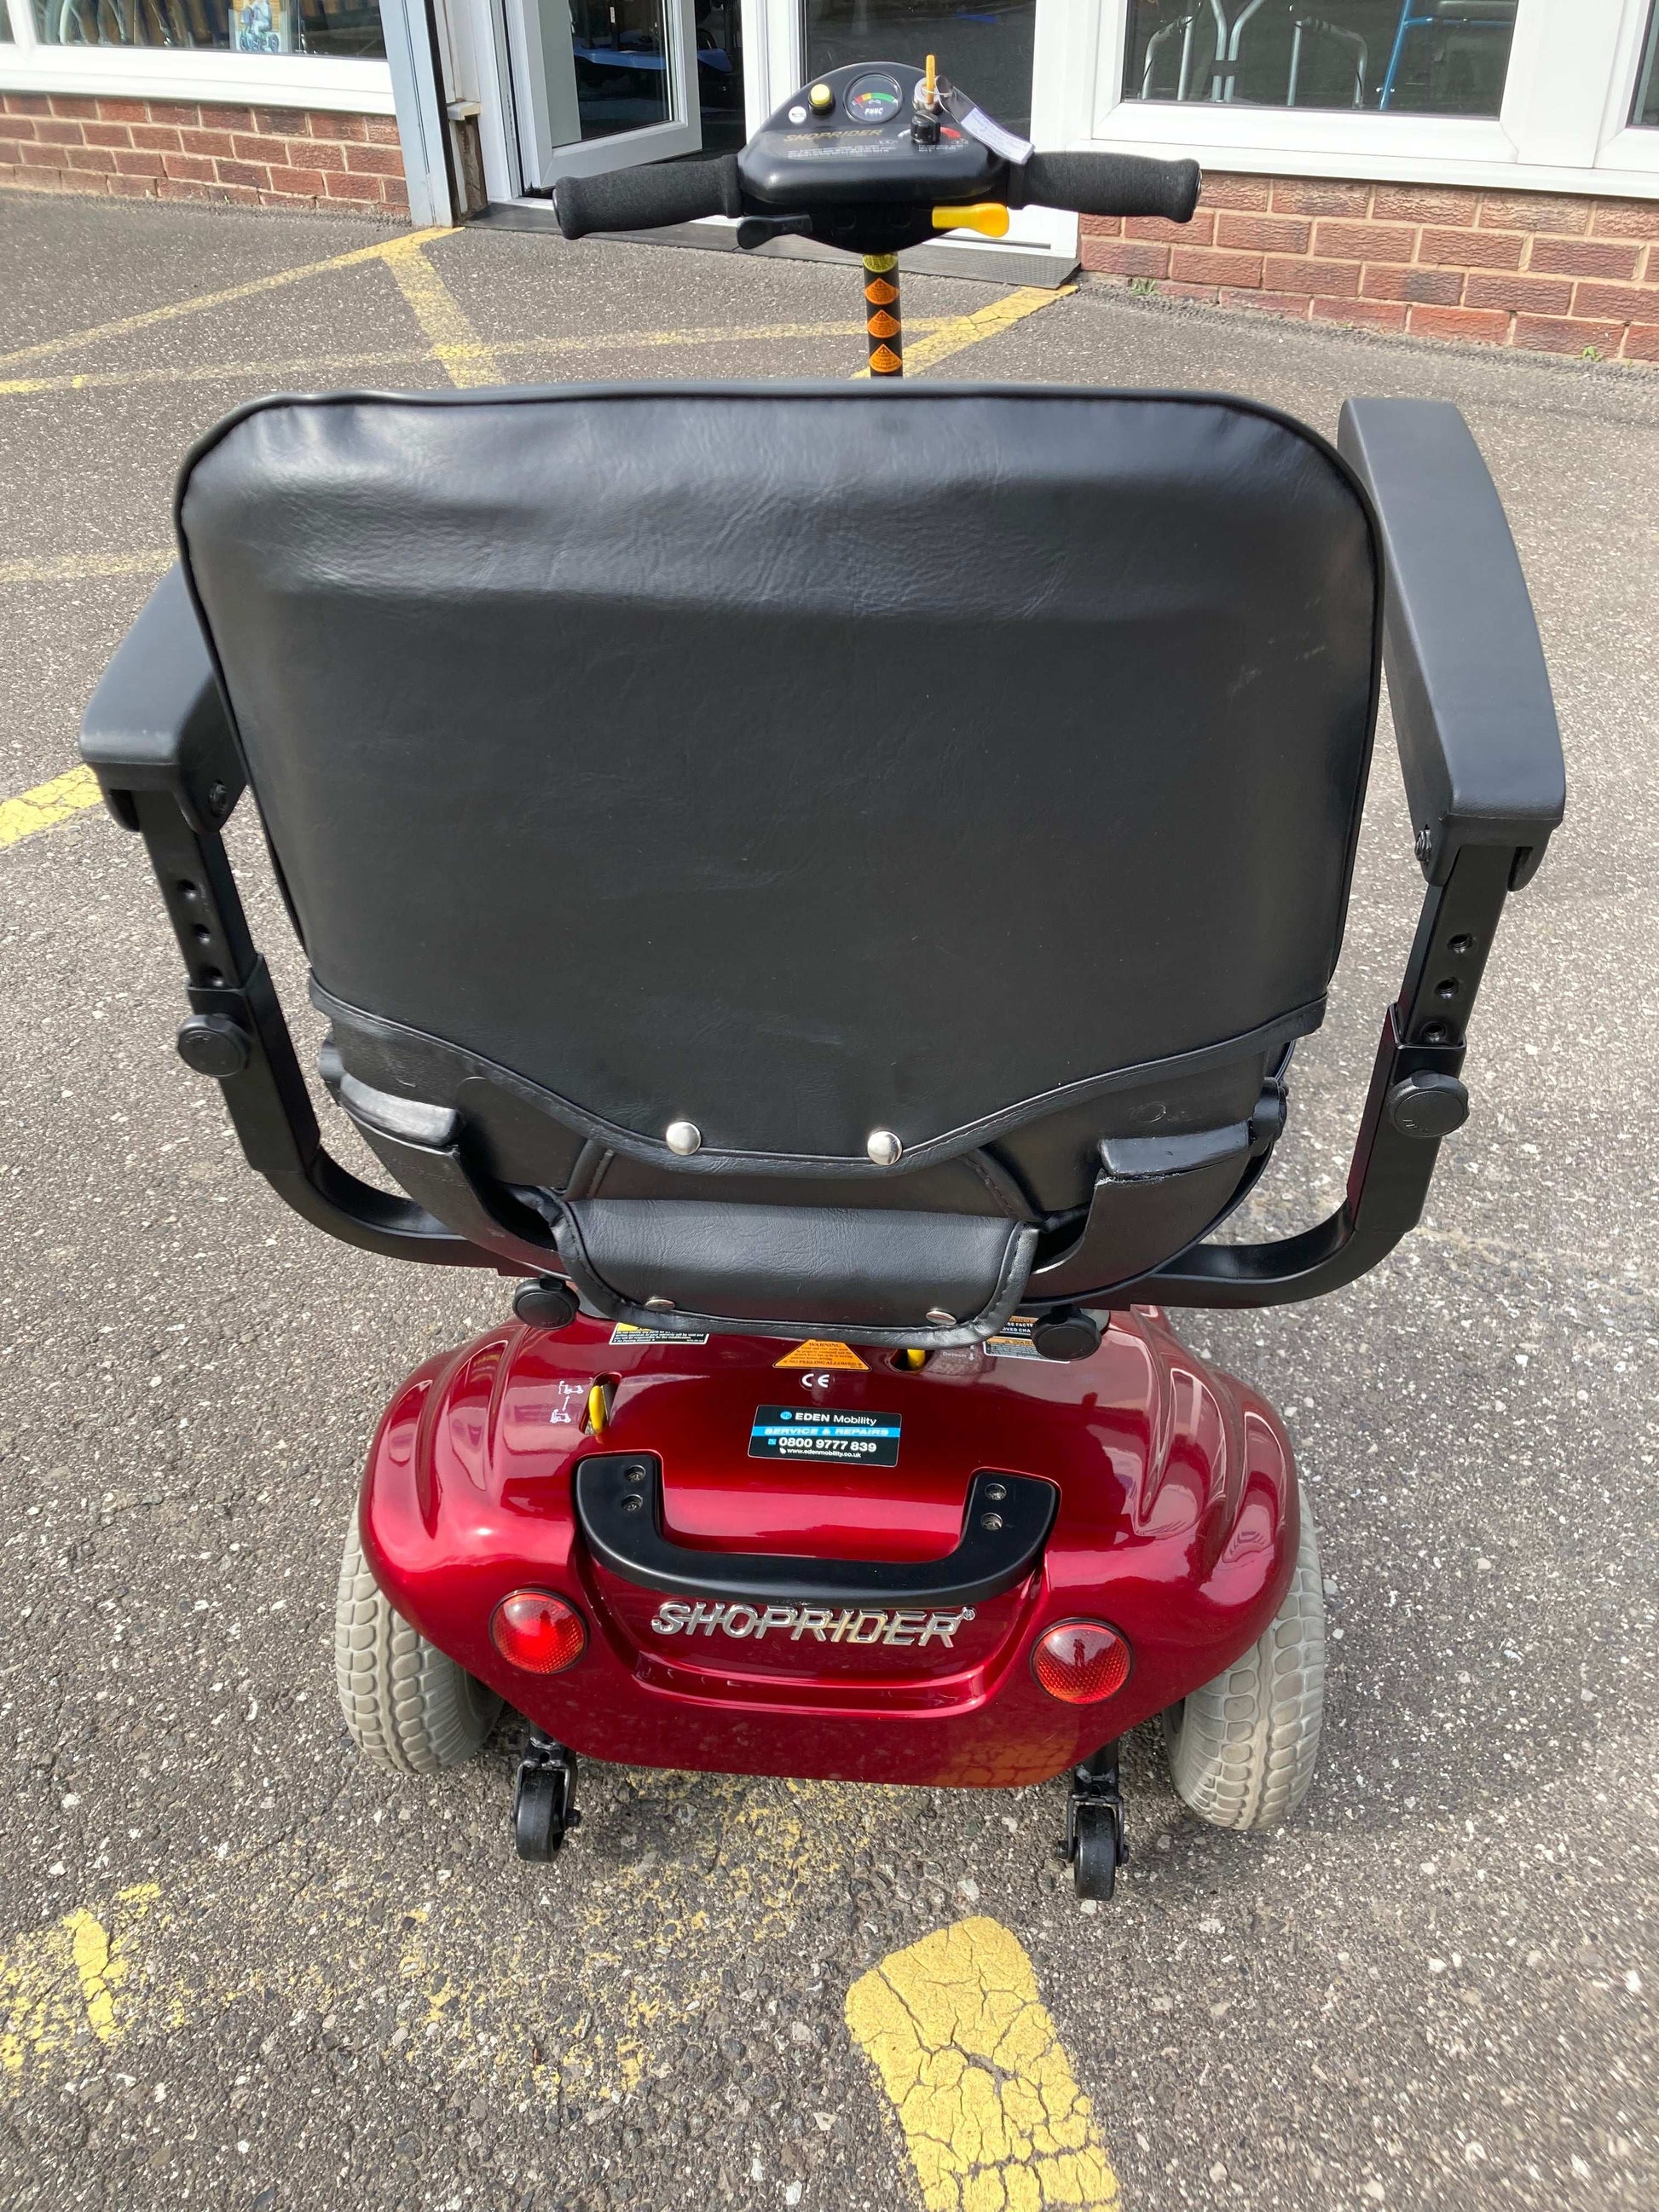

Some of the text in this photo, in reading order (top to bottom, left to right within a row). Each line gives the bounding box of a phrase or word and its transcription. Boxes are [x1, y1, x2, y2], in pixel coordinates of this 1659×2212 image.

[783, 129, 883, 141] SHOPRIDER
[795, 1412, 877, 1426] EDEN Mobility
[835, 1428, 889, 1436] REPAIRS
[778, 1437, 877, 1453] 0800 9777 839
[787, 1448, 862, 1458] www.edenmobility.co.uk
